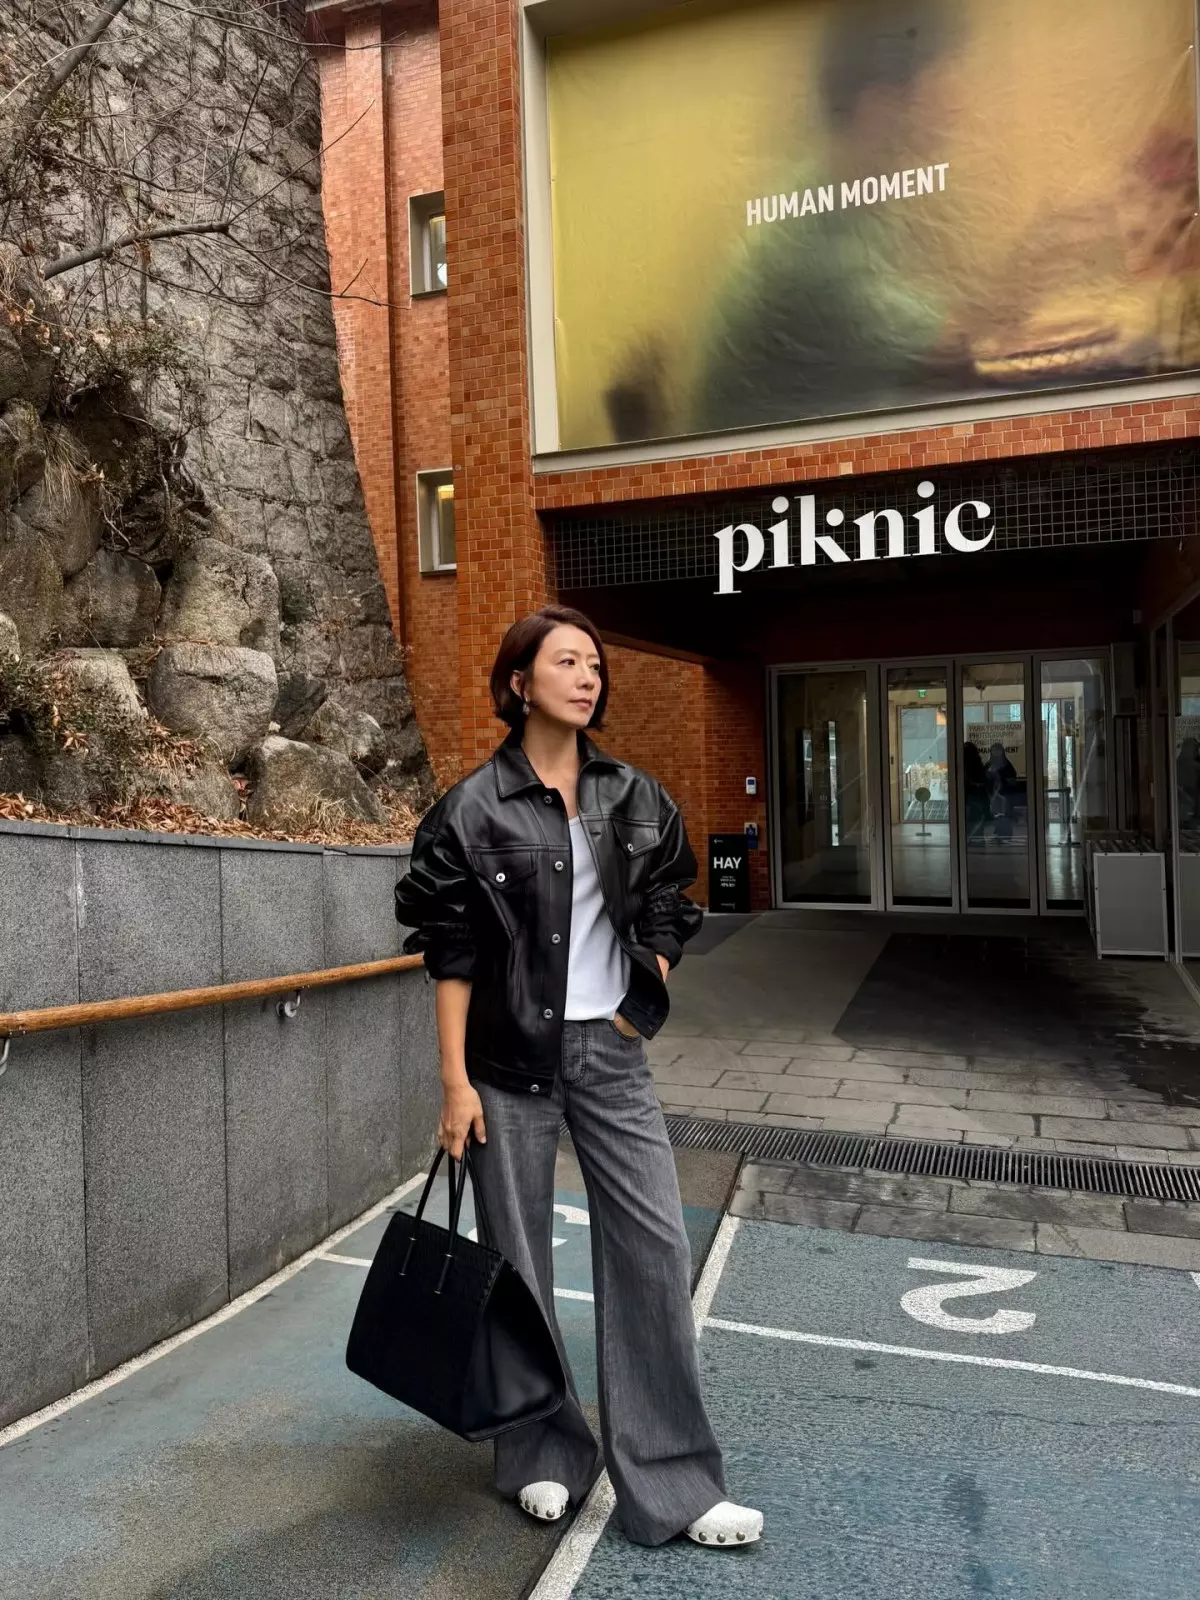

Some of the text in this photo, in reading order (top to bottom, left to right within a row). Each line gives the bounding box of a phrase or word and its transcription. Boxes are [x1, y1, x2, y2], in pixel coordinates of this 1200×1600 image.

[747, 162, 950, 226] HUMAN MOMENT
[713, 480, 996, 594] piknic
[713, 856, 742, 869] HAY
[900, 1256, 1037, 1334] 2
